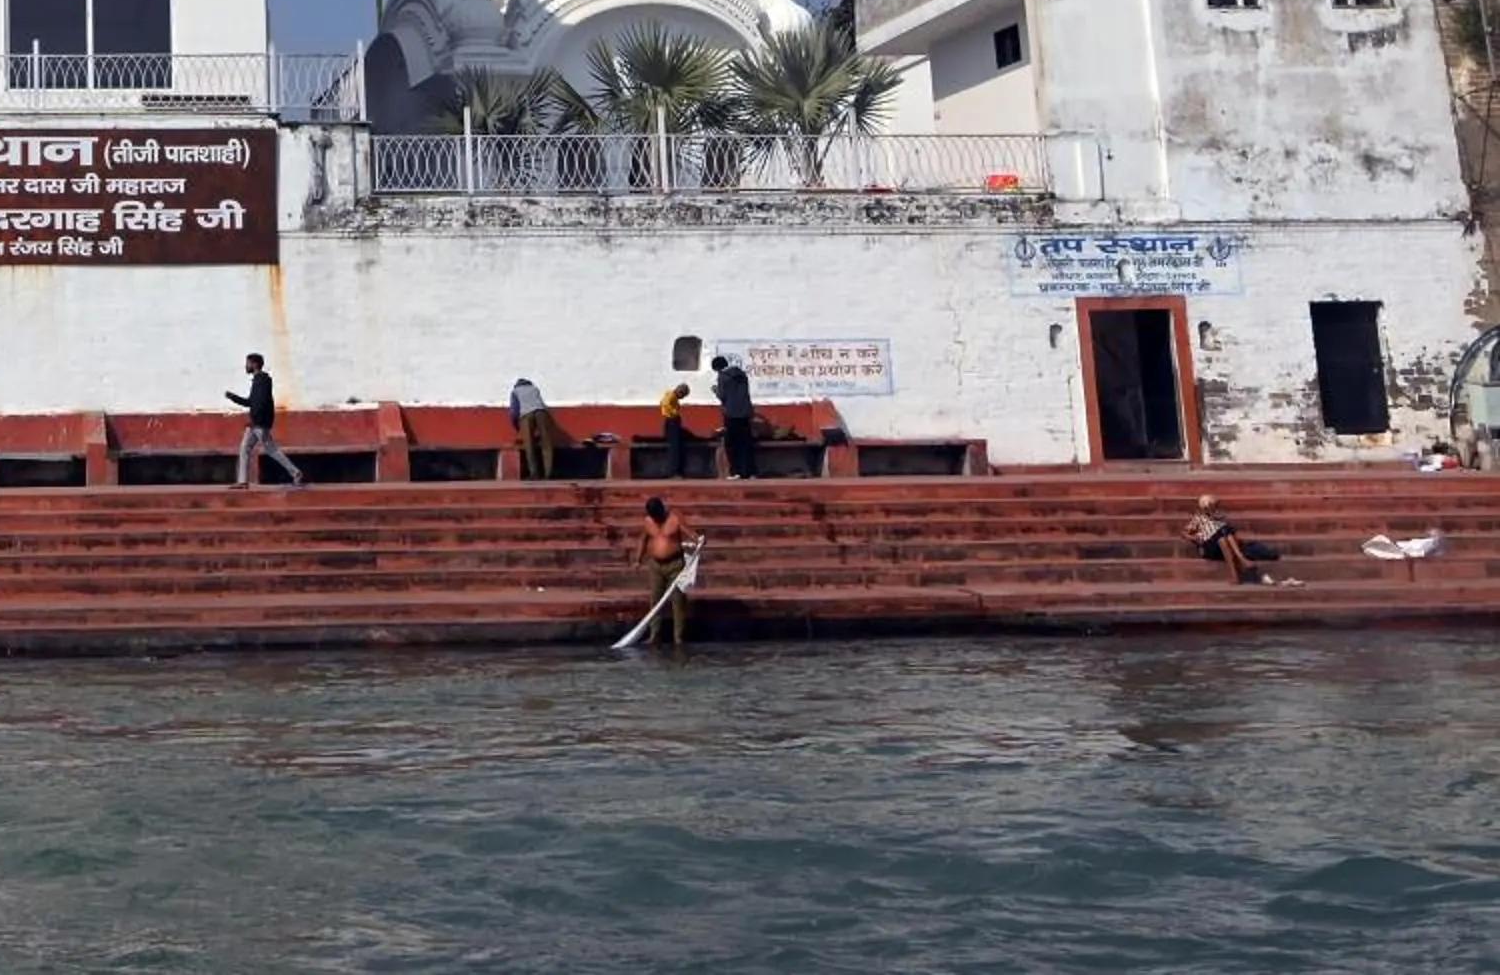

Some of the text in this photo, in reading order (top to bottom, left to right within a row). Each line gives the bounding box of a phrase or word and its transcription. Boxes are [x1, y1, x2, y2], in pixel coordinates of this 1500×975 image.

[104, 138, 160, 170] (तीजी
[164, 138, 250, 170] पातशाही)
[24, 178, 65, 194] दास
[70, 172, 100, 194] जी
[105, 178, 186, 195] महाराज
[112, 199, 186, 232] सिंह
[194, 199, 246, 230] जी
[9, 236, 53, 256] रंजय
[57, 236, 94, 256] सिंह
[98, 236, 123, 256] जी
[1039, 236, 1198, 255] तप स्थान
